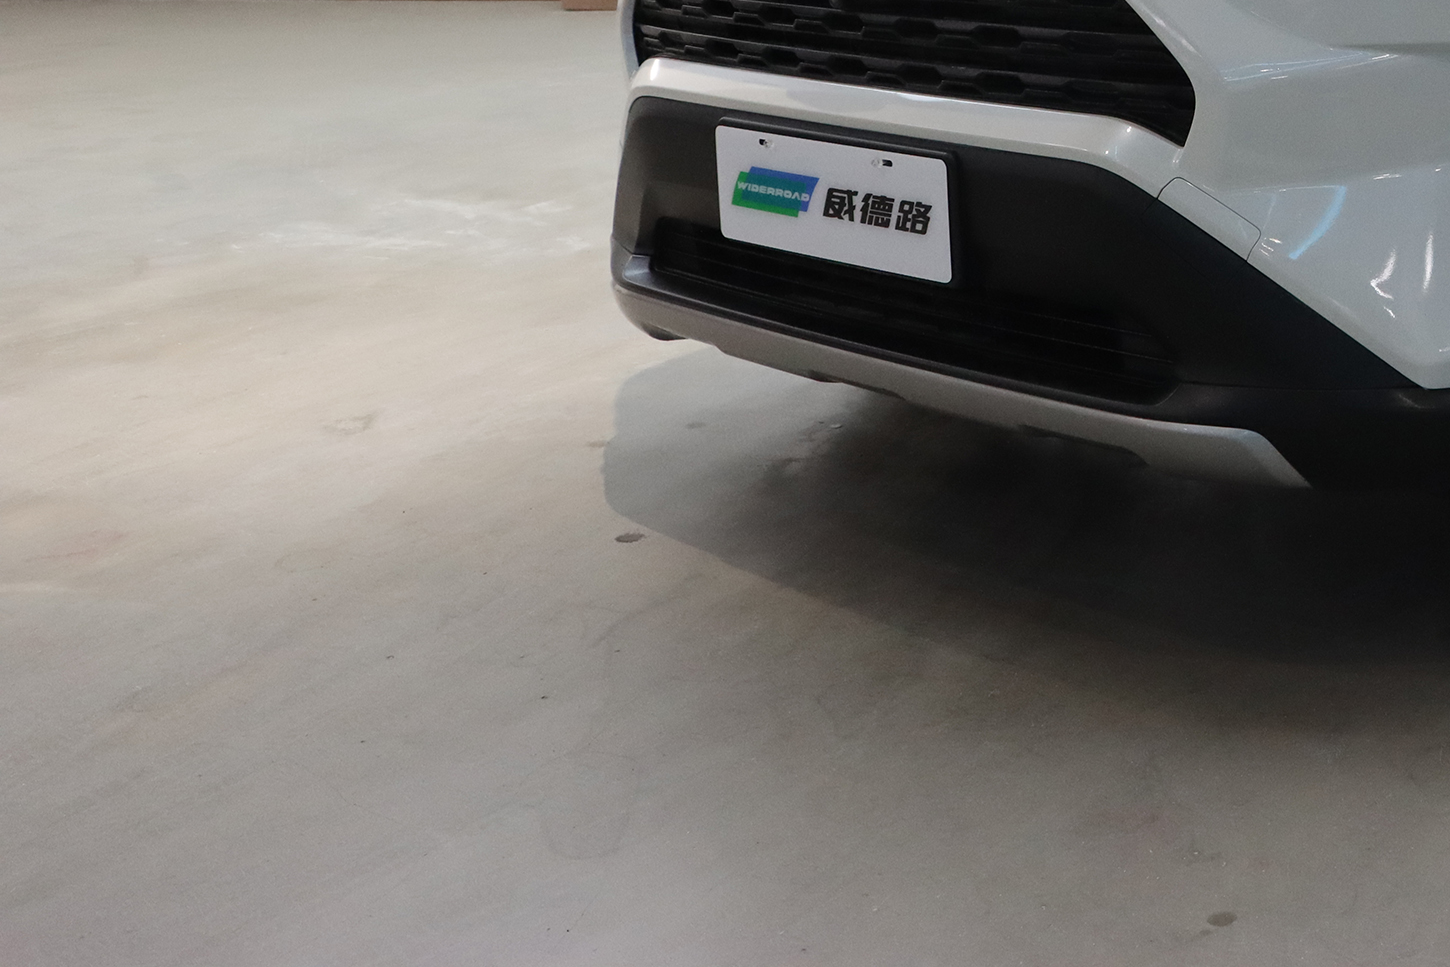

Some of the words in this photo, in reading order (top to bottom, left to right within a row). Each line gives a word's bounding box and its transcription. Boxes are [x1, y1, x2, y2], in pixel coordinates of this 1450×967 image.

[737, 180, 810, 202] WIDERROAD
[823, 187, 933, 235] 威德路
